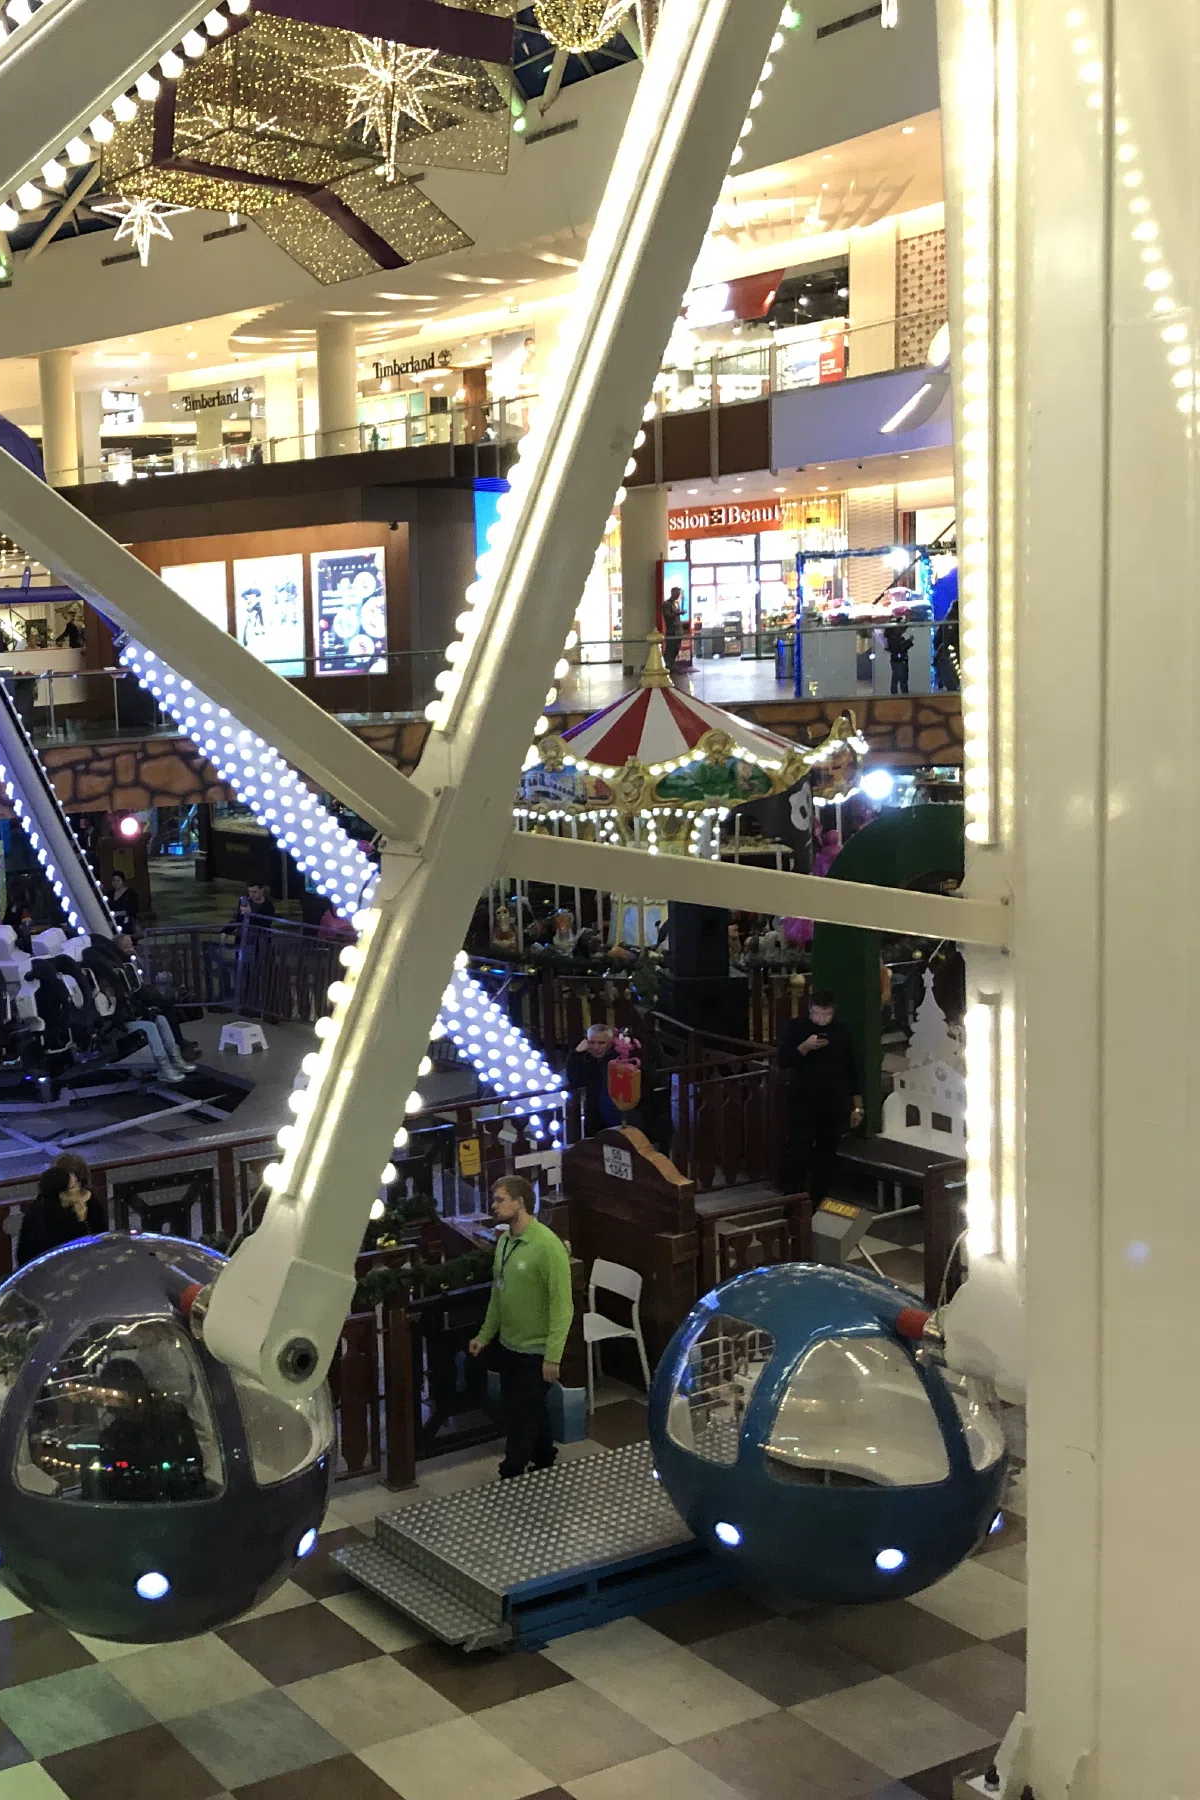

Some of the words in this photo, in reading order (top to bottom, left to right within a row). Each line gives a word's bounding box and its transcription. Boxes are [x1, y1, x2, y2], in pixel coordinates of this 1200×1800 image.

[373, 352, 435, 379] Timberland
[182, 388, 239, 412] Timberland
[669, 510, 709, 530] ssion
[728, 504, 788, 524] Beauty
